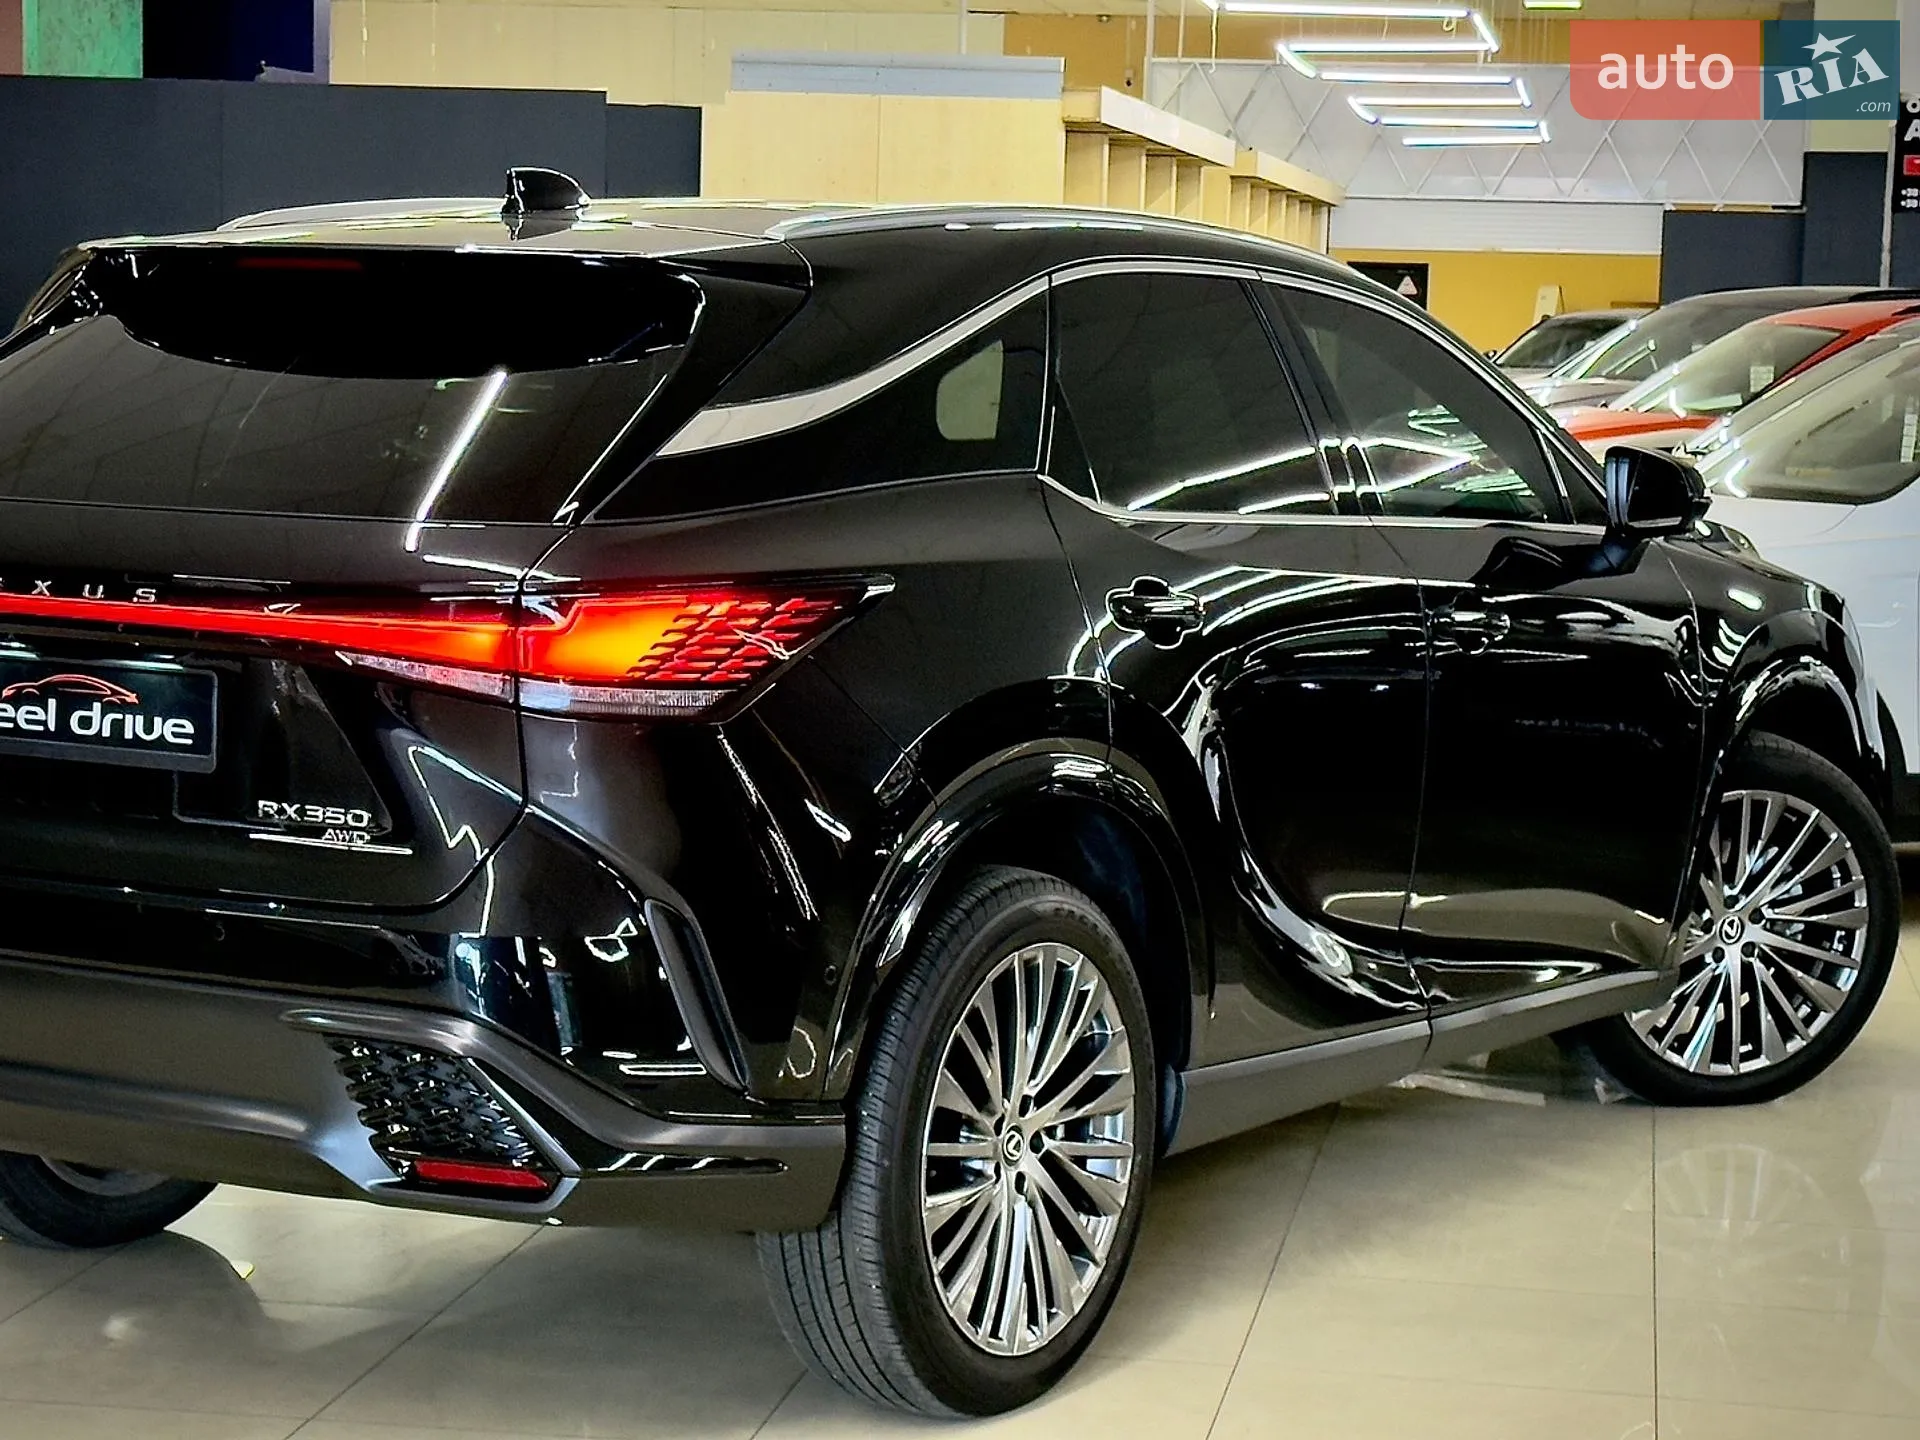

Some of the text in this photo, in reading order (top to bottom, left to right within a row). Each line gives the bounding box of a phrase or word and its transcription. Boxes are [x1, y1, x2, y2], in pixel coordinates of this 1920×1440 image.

[0, 577, 157, 603] XUS
[70, 702, 195, 746] drive
[322, 828, 371, 844] AWD
